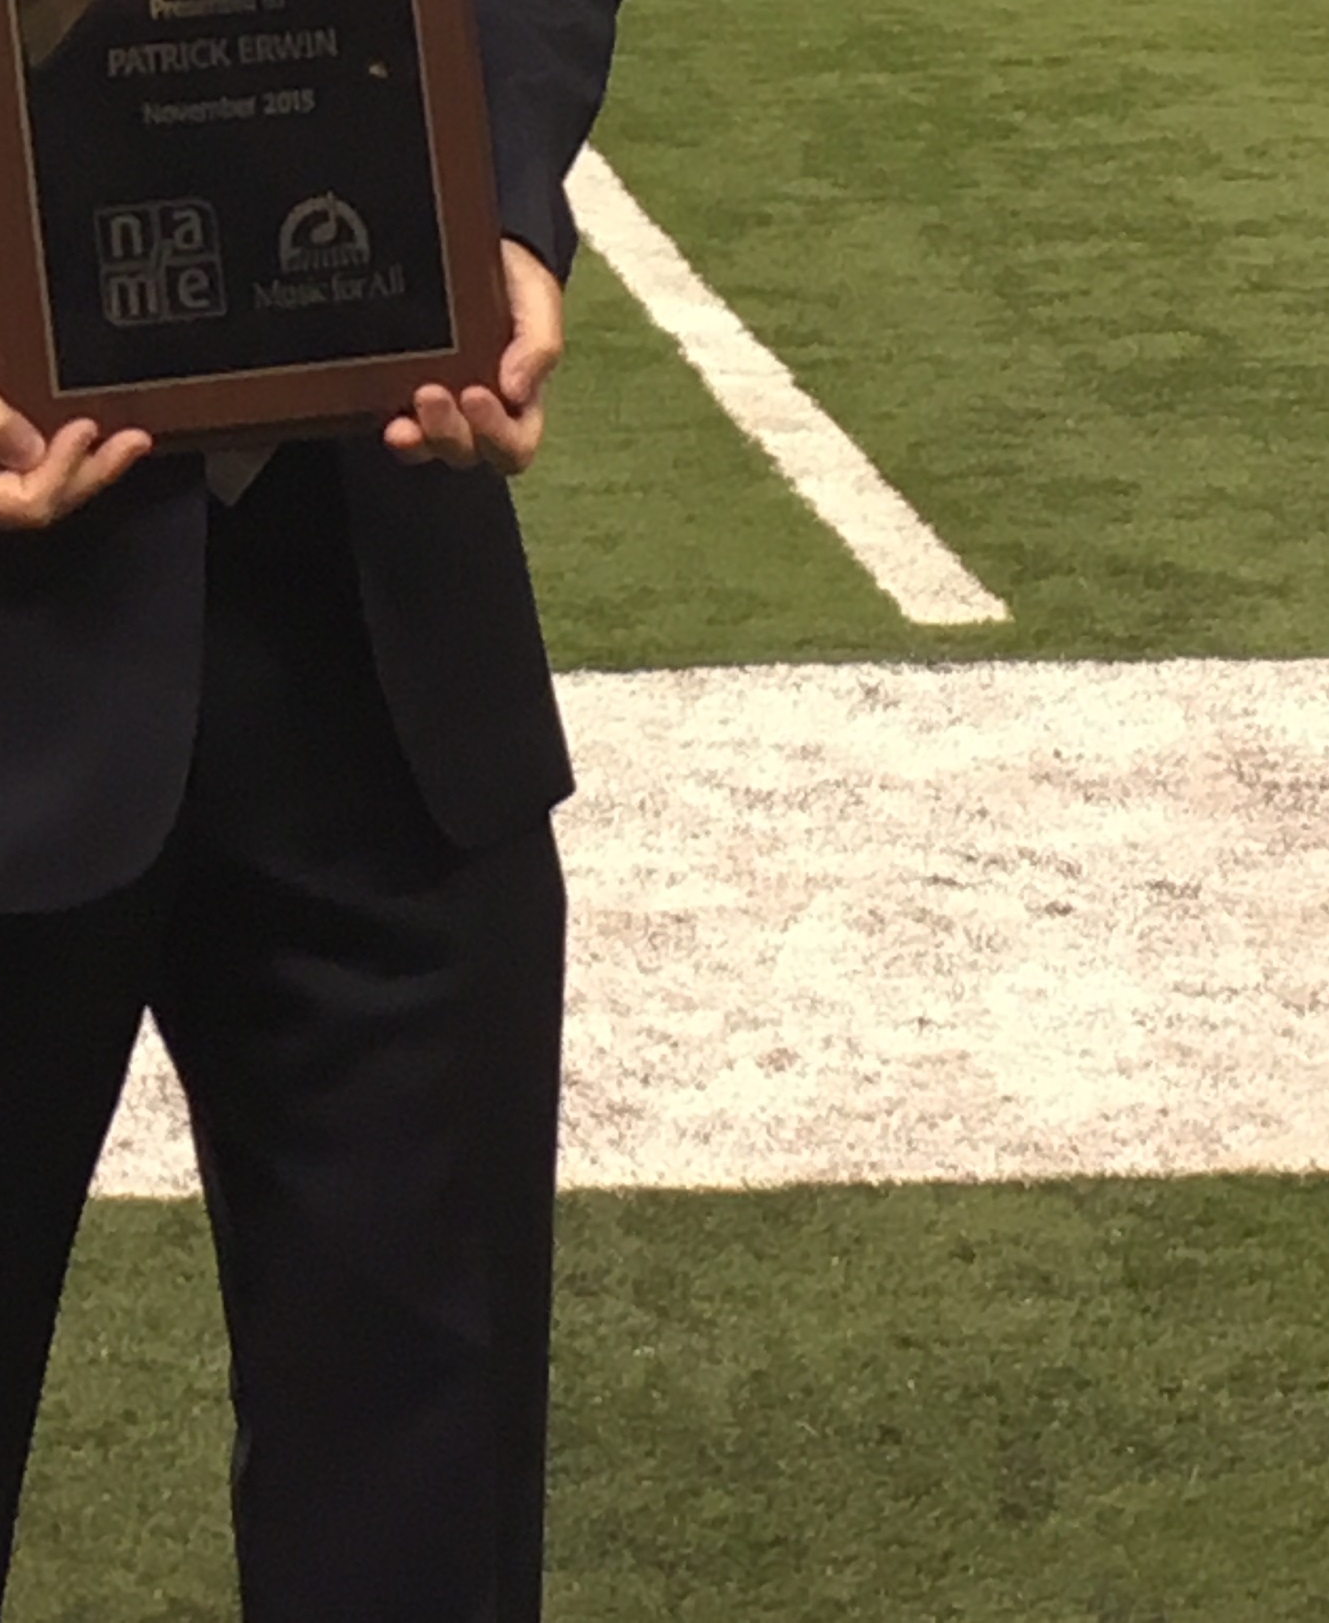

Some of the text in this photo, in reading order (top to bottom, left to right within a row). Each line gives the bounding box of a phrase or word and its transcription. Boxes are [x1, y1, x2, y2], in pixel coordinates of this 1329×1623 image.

[106, 27, 339, 77] PATRICK ERWIN
[142, 87, 316, 125] November 2015
[253, 262, 407, 312] Music for All
